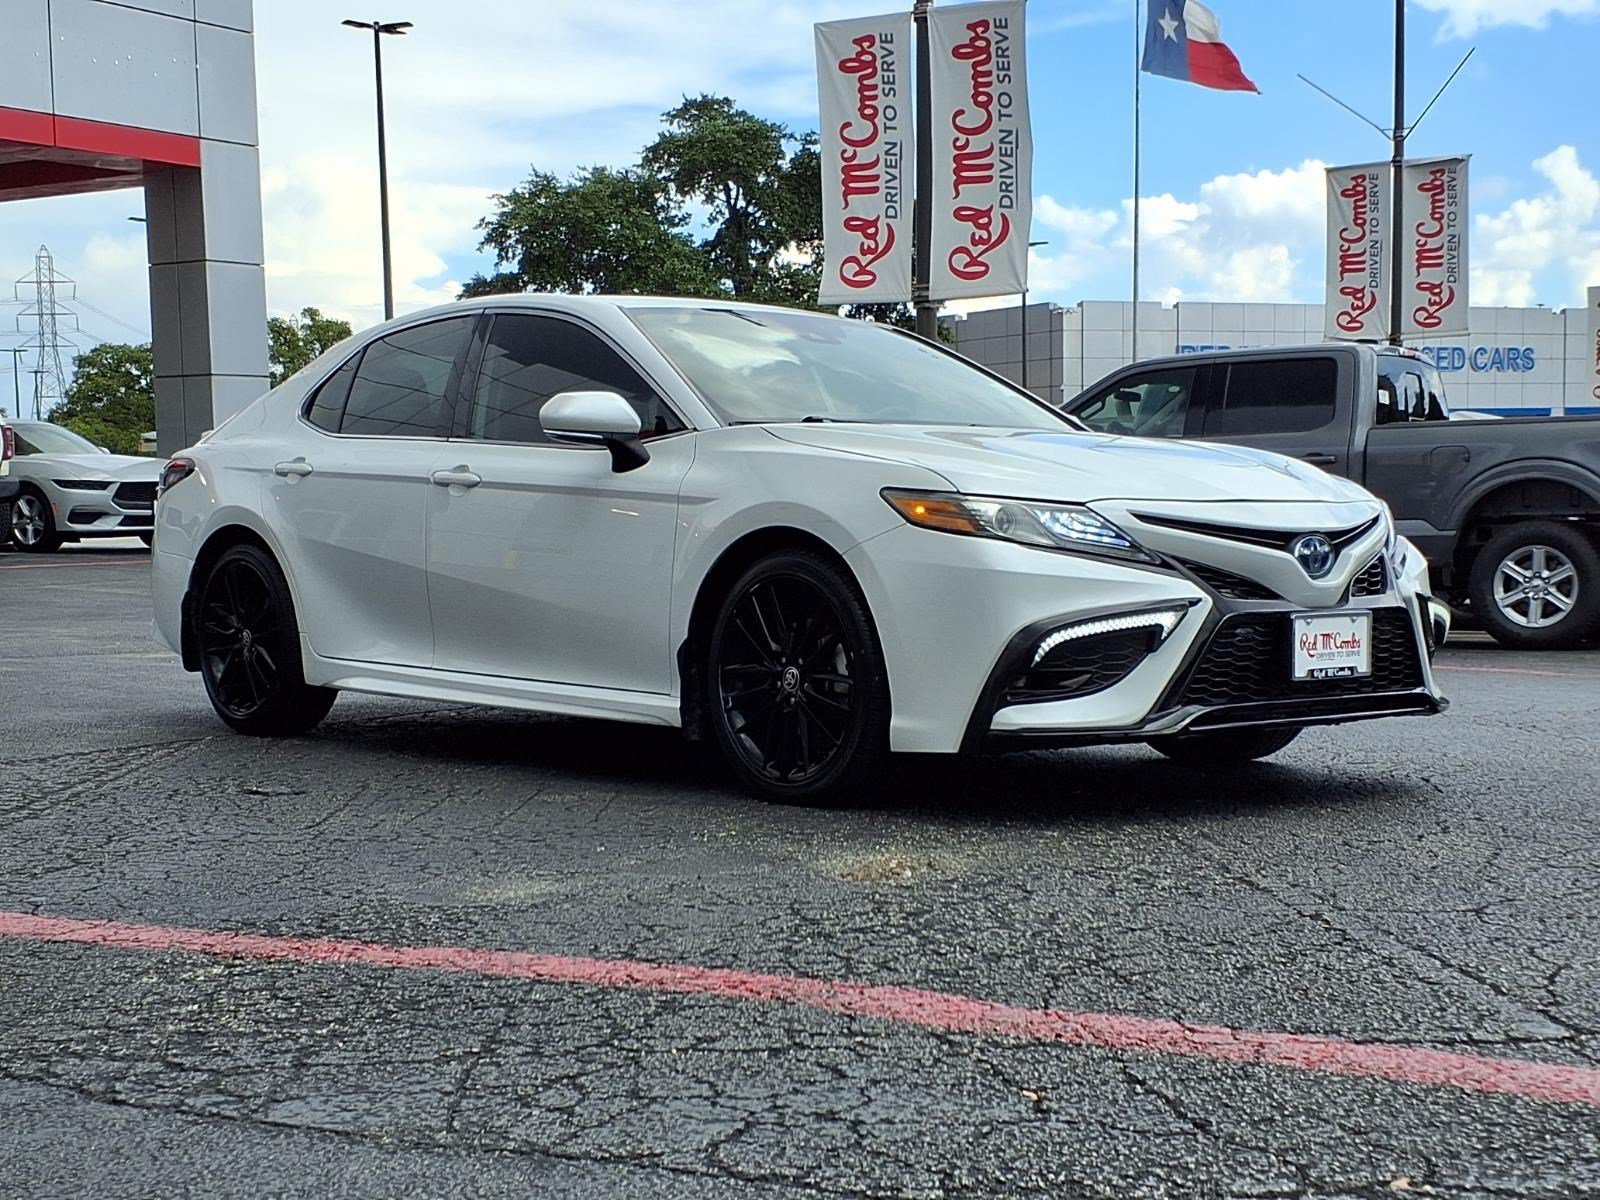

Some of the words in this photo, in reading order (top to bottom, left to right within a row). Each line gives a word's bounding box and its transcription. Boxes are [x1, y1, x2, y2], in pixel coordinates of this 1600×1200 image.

[879, 32, 897, 99] SERVE
[994, 17, 1012, 85] SERVE
[838, 33, 881, 210] McCombs
[883, 105, 898, 134] TO
[951, 18, 995, 200] McCombs
[997, 91, 1013, 122] TO
[885, 140, 898, 220] DRIVEN
[1000, 129, 1014, 210] DRIVEN
[1368, 173, 1379, 214] SERVE
[1447, 167, 1457, 207] SERVE
[948, 204, 1010, 281] Red
[1339, 173, 1367, 283] McCombs
[1369, 217, 1379, 236] TO
[1415, 168, 1446, 278] McCombs
[1447, 211, 1457, 230] TO
[839, 214, 896, 289] Red
[1369, 240, 1379, 289] DRIVEN
[1447, 234, 1457, 284] DRIVEN
[1336, 285, 1377, 332] Red
[1413, 280, 1455, 329] Red
[1421, 346, 1466, 371] SED
[1472, 347, 1535, 371] CARS
[1300, 633, 1318, 658] Red
[1319, 632, 1361, 650] McCombs
